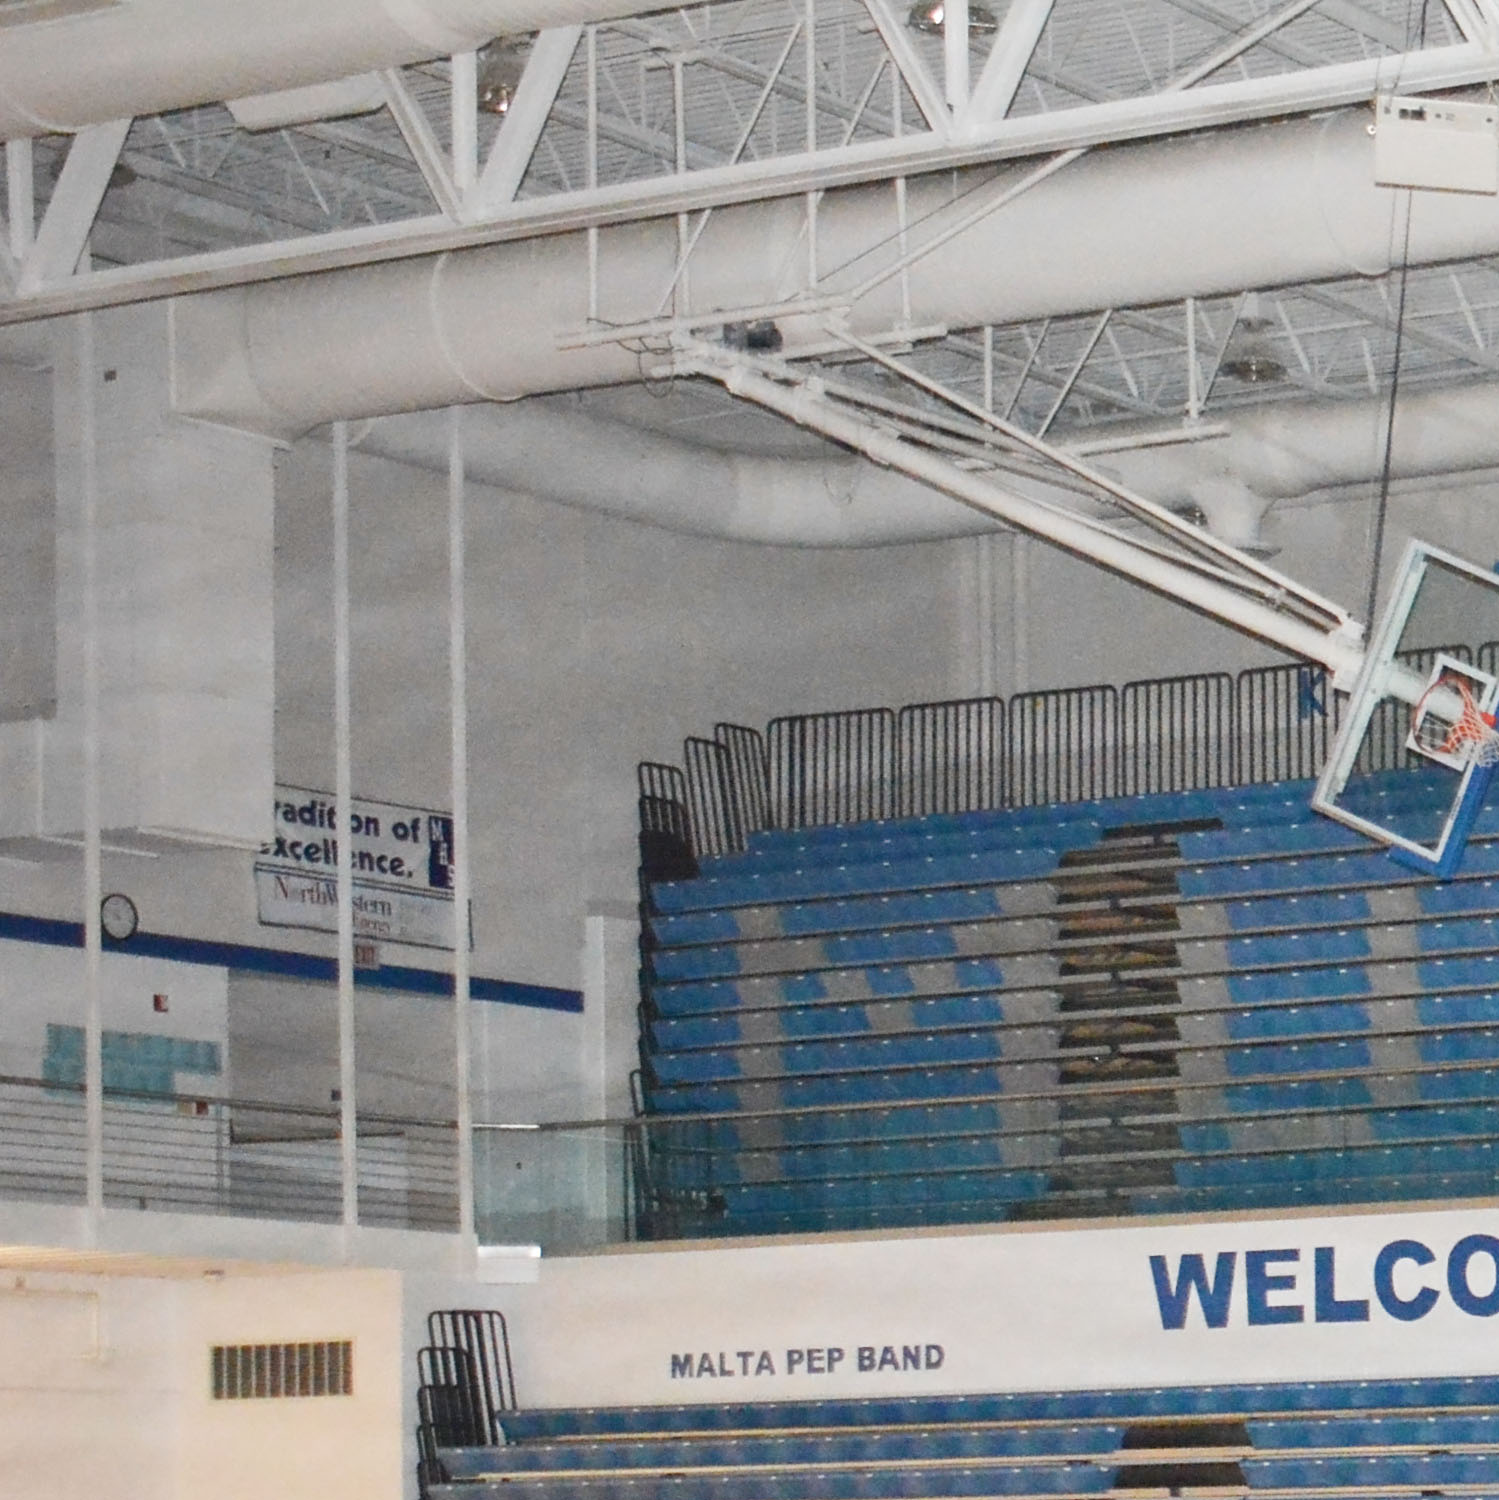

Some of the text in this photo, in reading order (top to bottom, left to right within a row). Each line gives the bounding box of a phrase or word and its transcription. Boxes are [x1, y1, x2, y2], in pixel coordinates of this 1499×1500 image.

[392, 817, 420, 844] of
[259, 836, 414, 878] xcellnce.
[670, 1344, 945, 1379] MALTA PEP BAND
